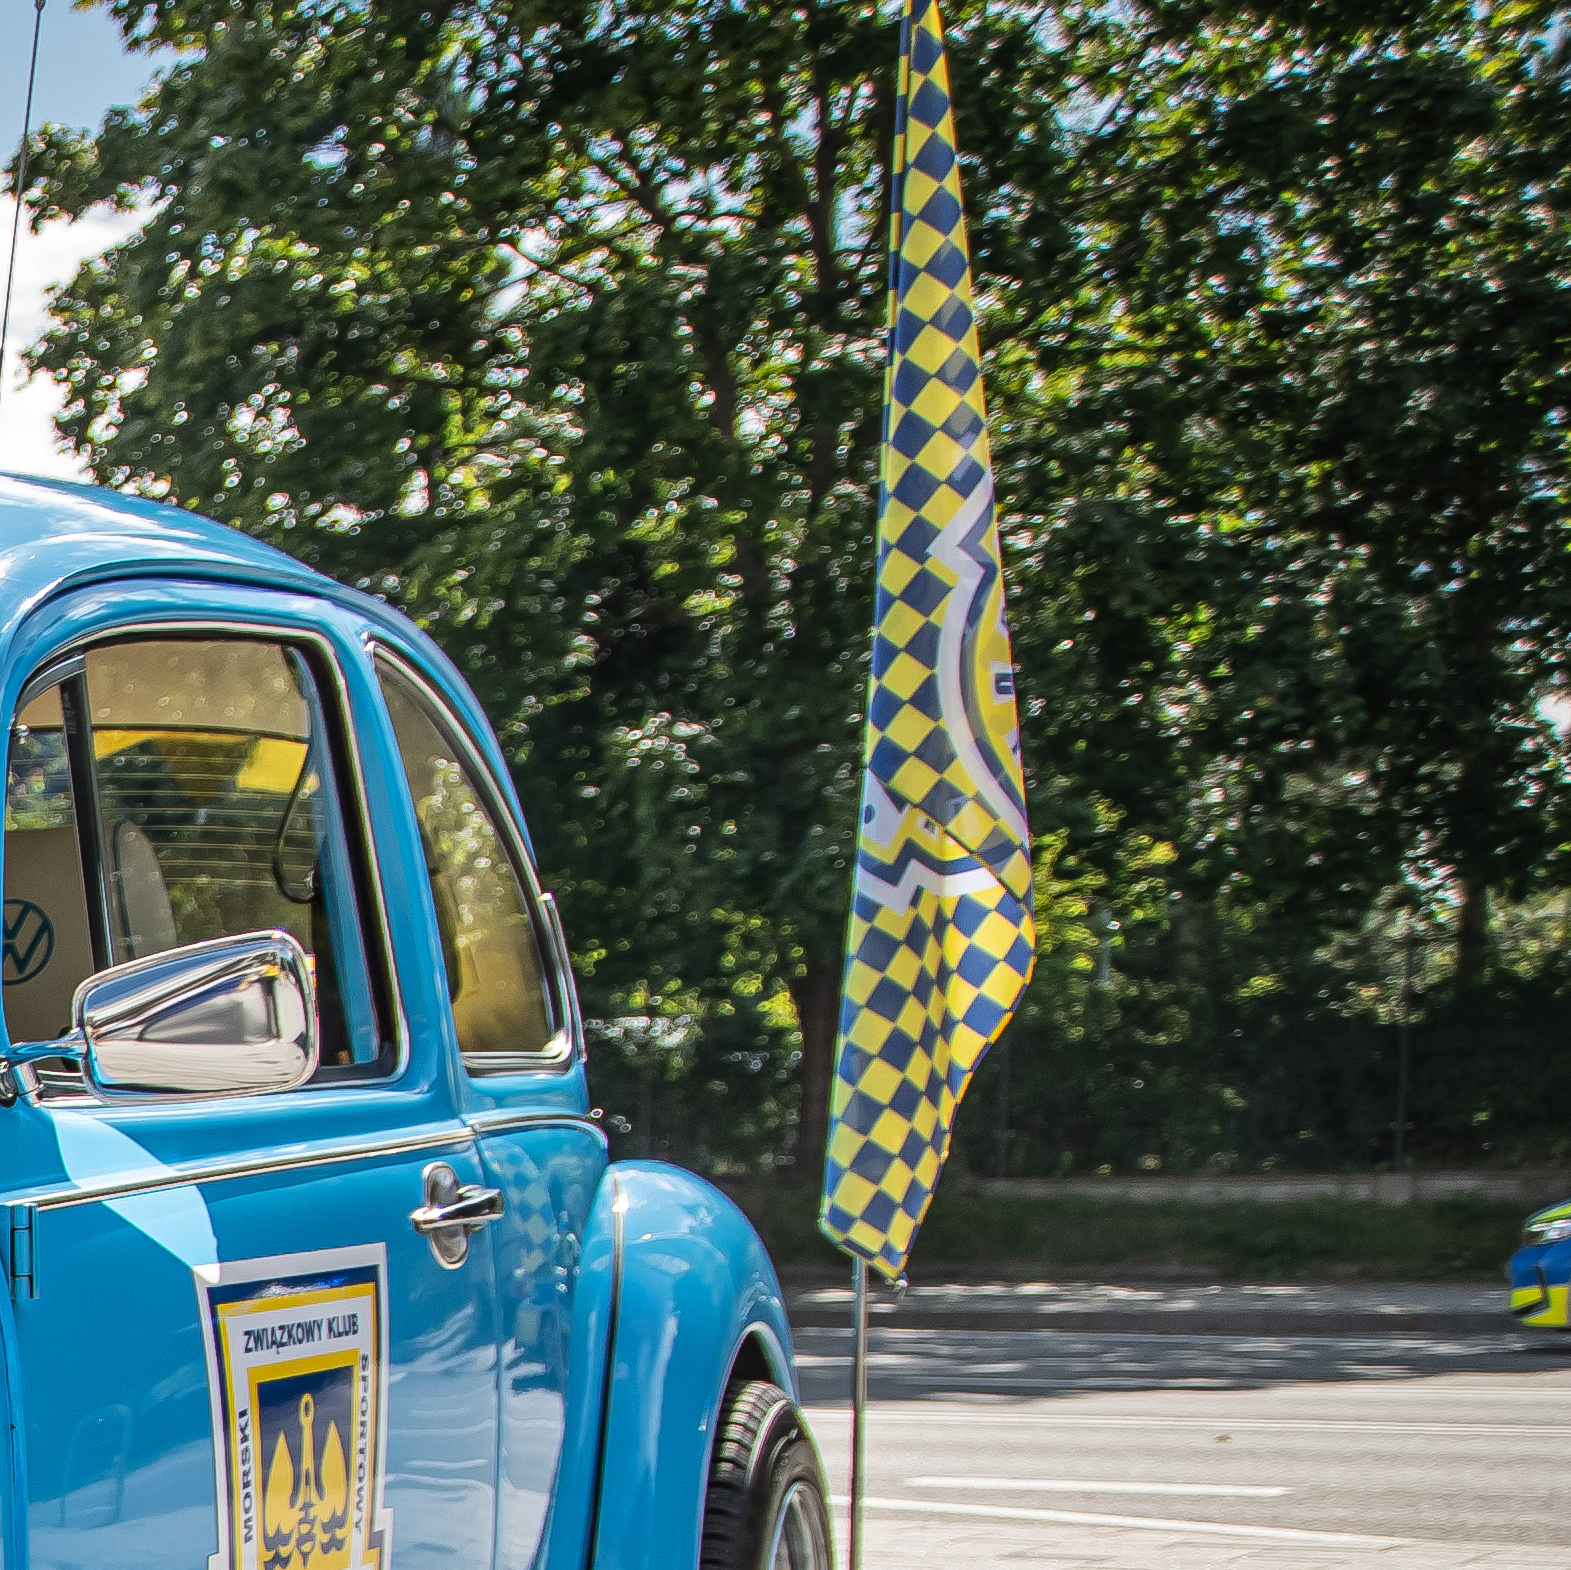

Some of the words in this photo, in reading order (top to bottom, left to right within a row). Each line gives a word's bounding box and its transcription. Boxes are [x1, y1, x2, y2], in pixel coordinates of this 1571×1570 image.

[243, 1317, 325, 1355] ZWIĄZKOWY
[327, 1313, 360, 1339] KLUB
[238, 1407, 254, 1544] MORSKI
